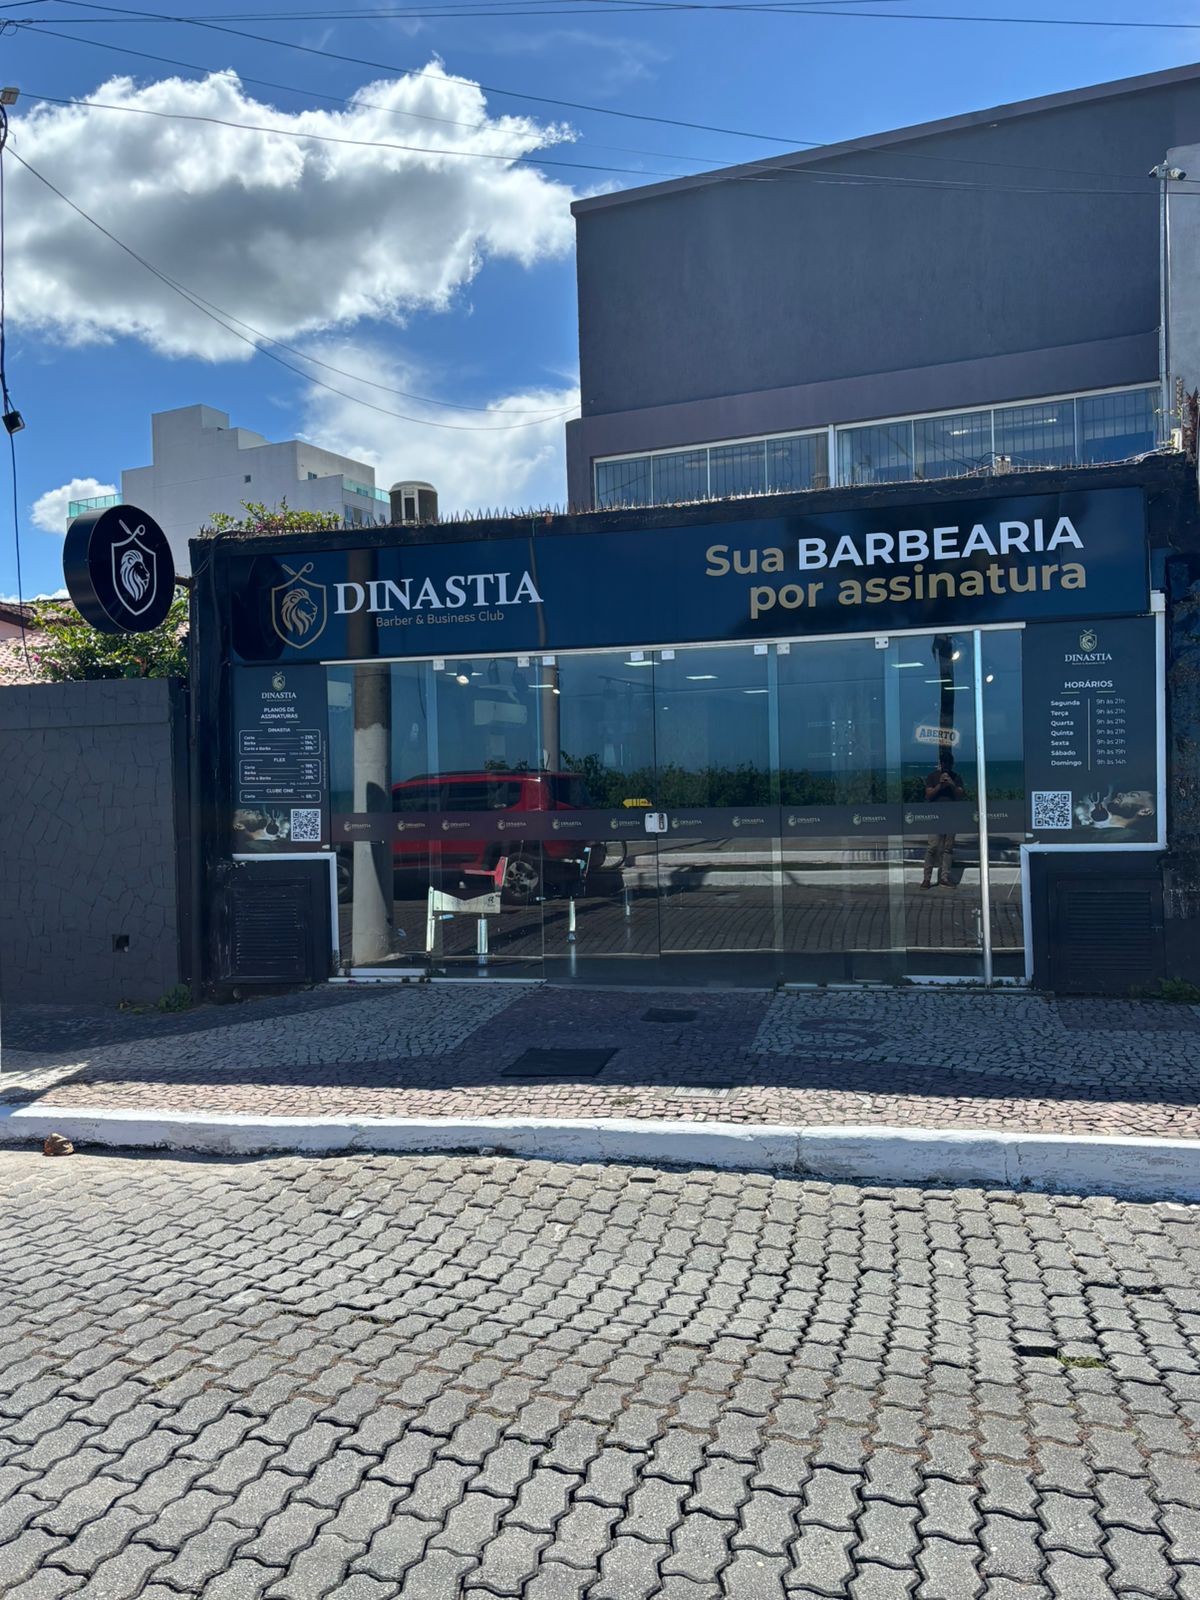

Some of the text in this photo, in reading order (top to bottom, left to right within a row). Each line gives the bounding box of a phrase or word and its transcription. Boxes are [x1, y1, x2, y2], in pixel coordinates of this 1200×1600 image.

[705, 516, 1084, 577] Sua BARBEARIA
[333, 570, 544, 615] DINASTIA
[750, 562, 1086, 619] por assinatura
[376, 609, 504, 627] Barber & Business Club
[1064, 653, 1112, 662] DINASTIA
[1064, 679, 1113, 689] HORÁRIOS
[261, 691, 297, 699] DINASTIA
[920, 728, 956, 741] ABERTO
